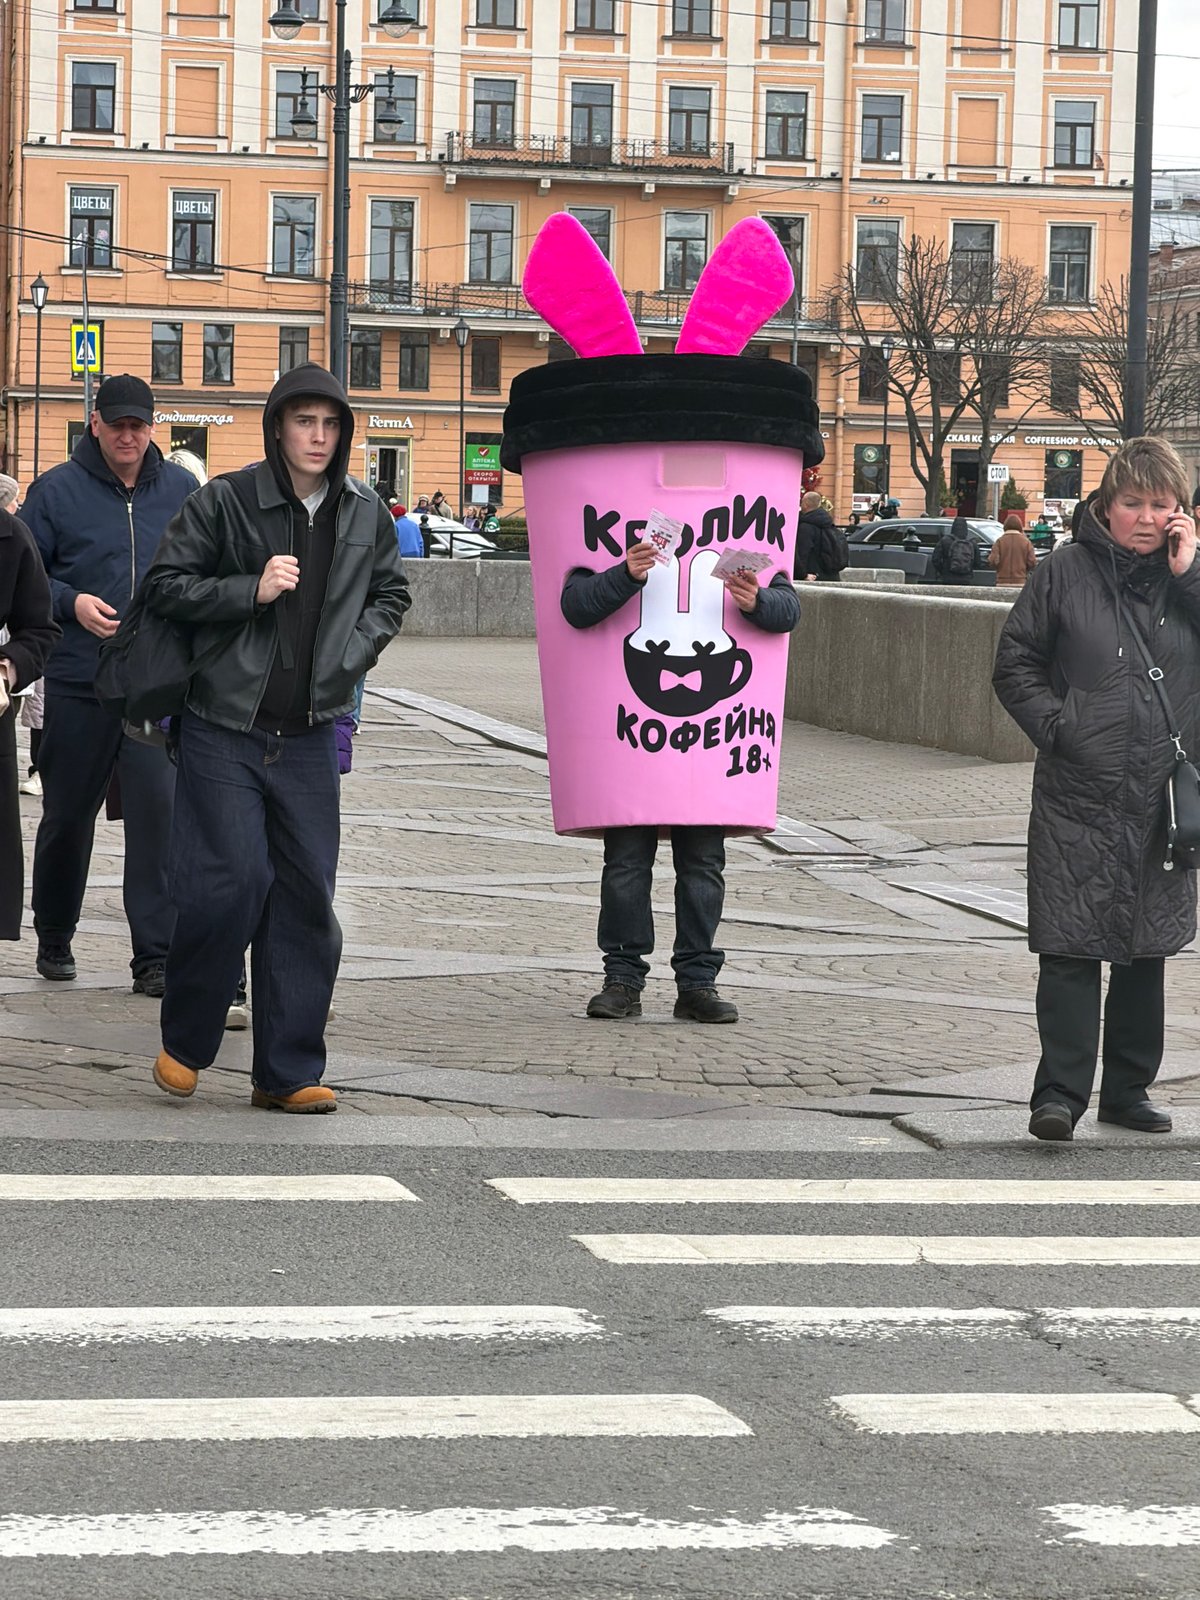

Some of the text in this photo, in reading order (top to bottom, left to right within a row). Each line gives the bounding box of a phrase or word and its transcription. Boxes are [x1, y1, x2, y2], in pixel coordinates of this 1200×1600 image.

[73, 195, 110, 210] ЦВЕТЫ
[176, 200, 212, 214] ЦВЕТЫ
[153, 410, 234, 426] Кондитерская
[368, 415, 414, 429] FermA
[971, 433, 1016, 444] КОЕЙНЯ
[1024, 436, 1079, 446] COFFEESHOP
[991, 467, 1006, 479] СТОП
[617, 703, 776, 753] КОФЕЙНЯ
[726, 744, 772, 778] 18+
